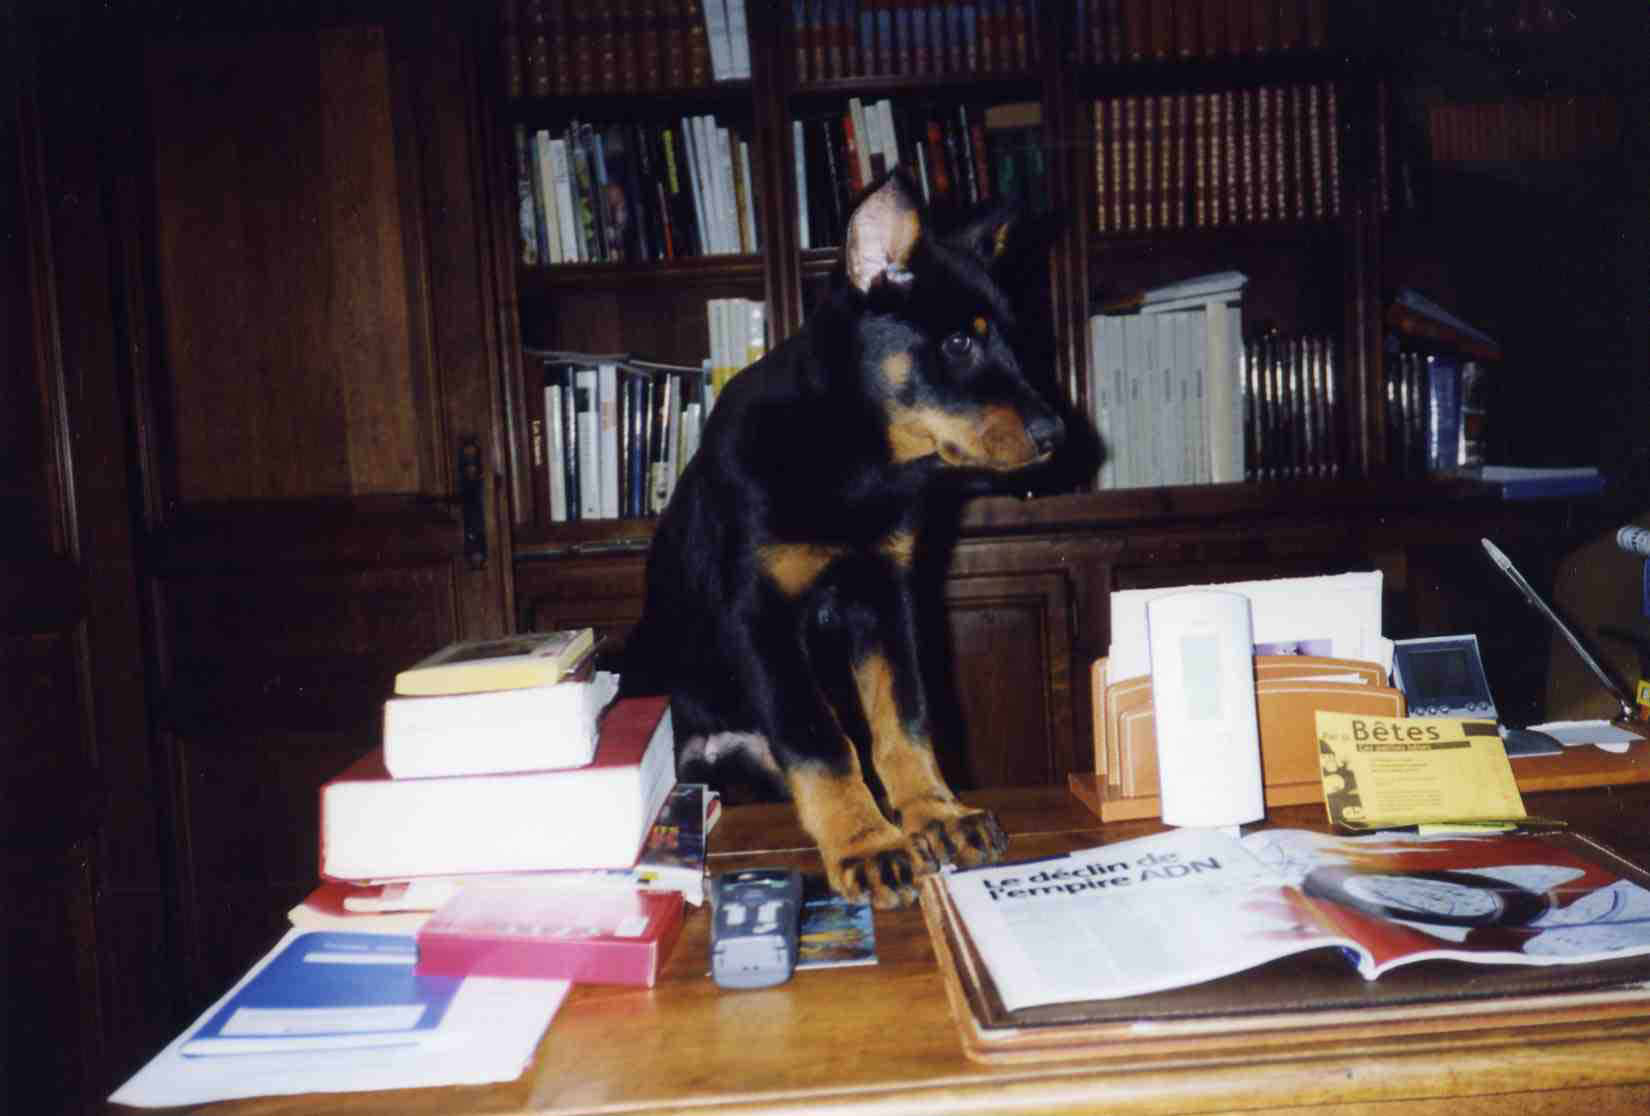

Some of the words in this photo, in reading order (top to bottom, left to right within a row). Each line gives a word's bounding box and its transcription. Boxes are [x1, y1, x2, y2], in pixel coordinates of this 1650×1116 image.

[1351, 719, 1441, 742] Bêtes
[983, 876, 1021, 890] Le
[1028, 860, 1130, 884] déclin
[1136, 852, 1178, 867] de
[988, 875, 1130, 901] l'empire
[1139, 856, 1222, 882] ADN
